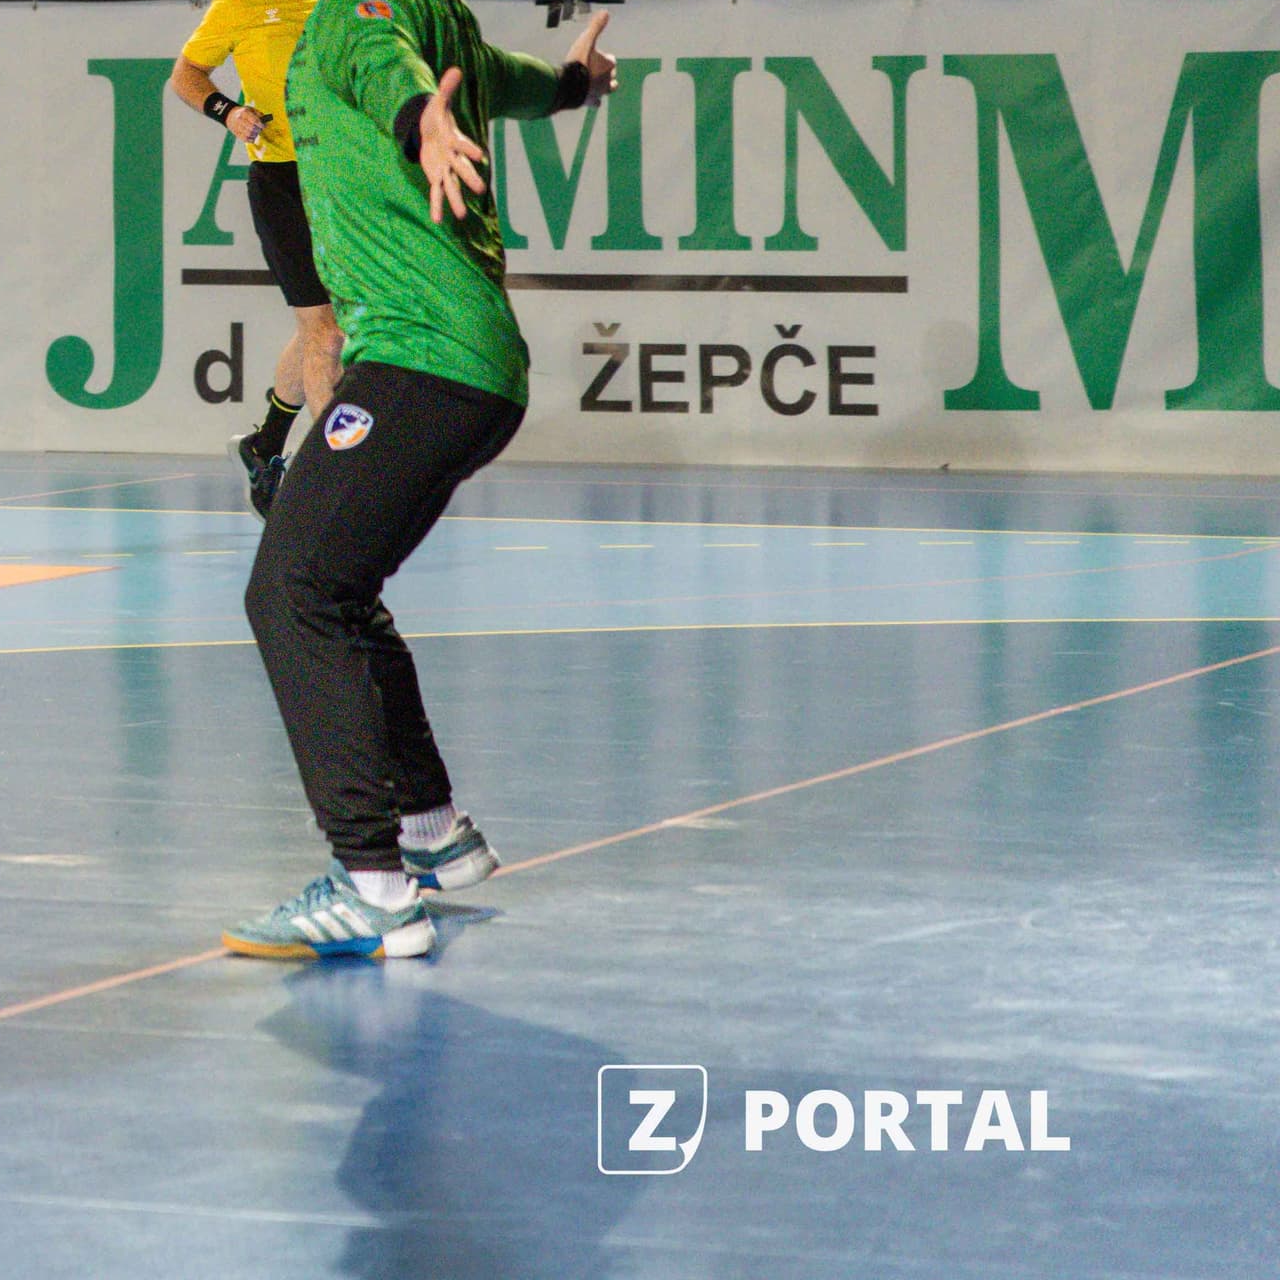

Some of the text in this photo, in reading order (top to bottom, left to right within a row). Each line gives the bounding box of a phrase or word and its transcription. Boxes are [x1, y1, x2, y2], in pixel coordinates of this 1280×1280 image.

[45, 51, 1280, 411] JMIN M
[579, 322, 880, 417] ŽEPČE
